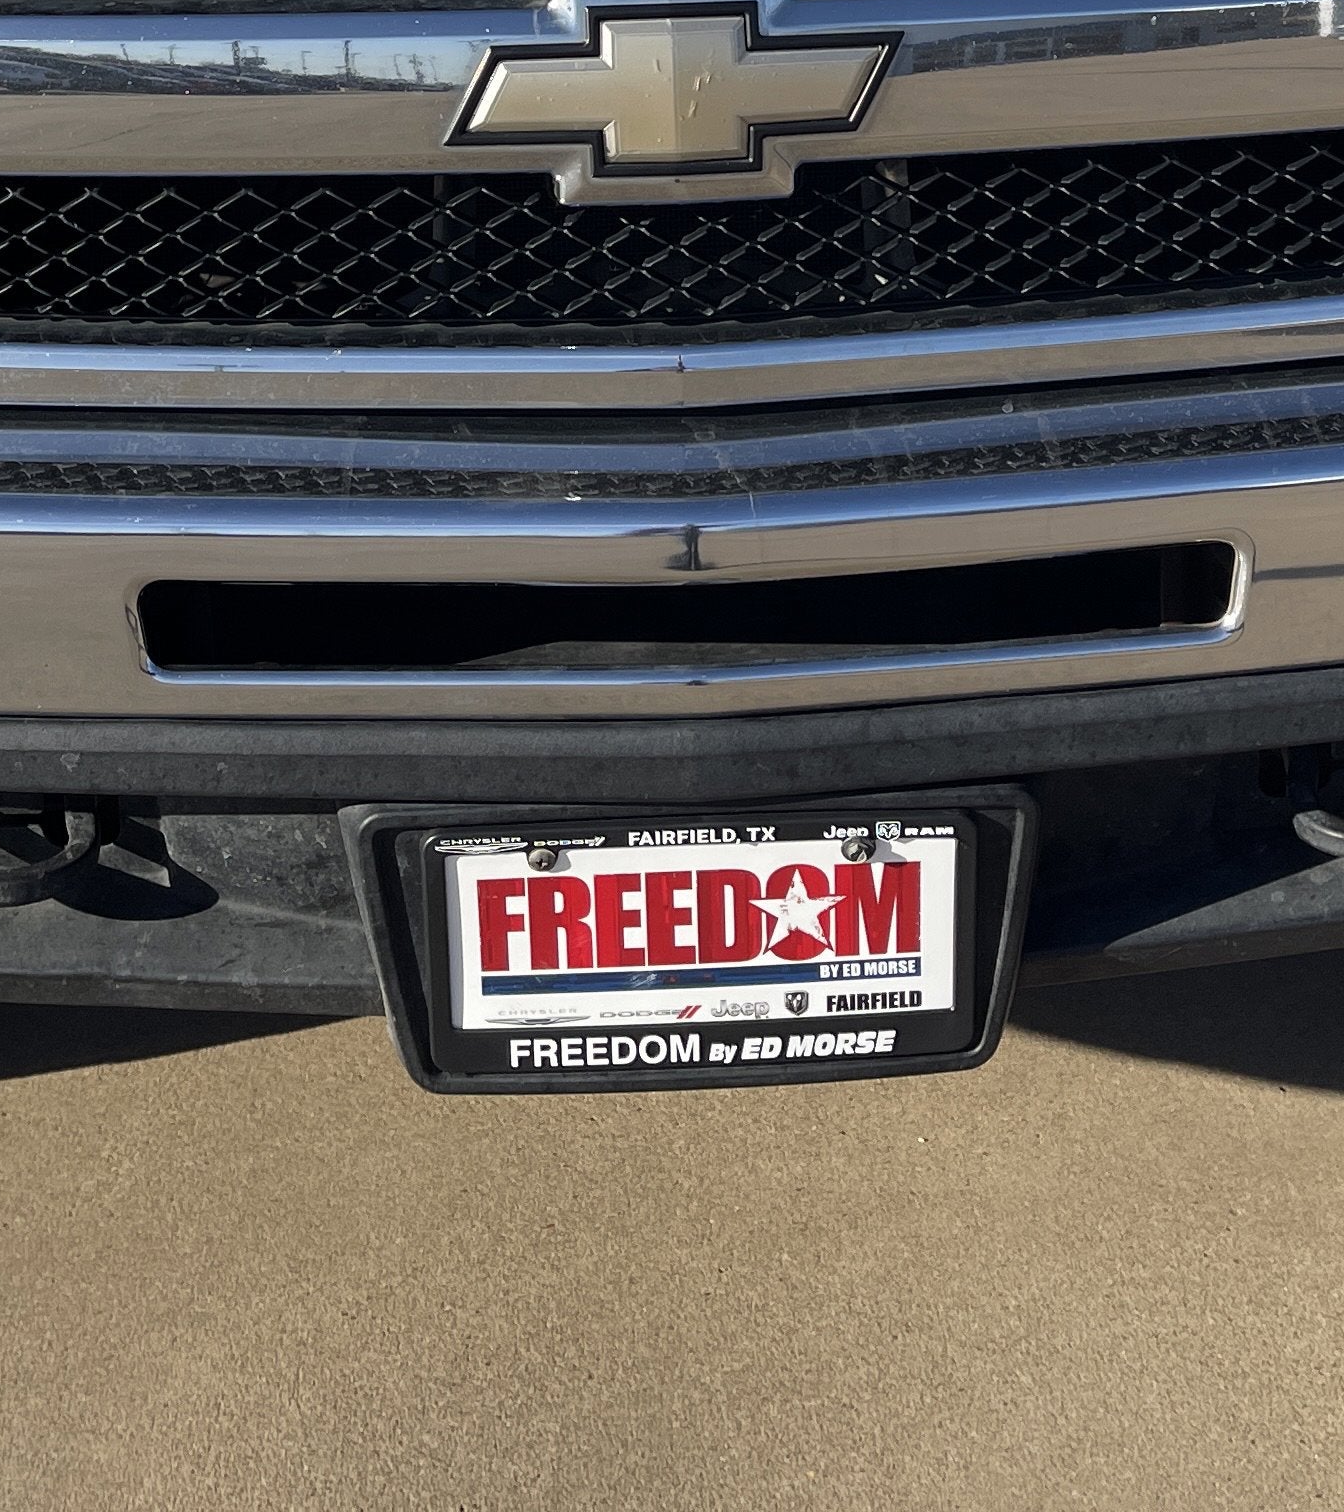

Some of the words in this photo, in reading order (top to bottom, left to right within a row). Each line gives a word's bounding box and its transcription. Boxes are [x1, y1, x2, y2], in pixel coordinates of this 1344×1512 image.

[439, 836, 522, 846] CHRYSLER
[628, 827, 741, 846] FAIRFIELD,
[746, 826, 776, 841] TX
[904, 826, 954, 836] RAM
[476, 861, 922, 972] FREEDOM
[819, 964, 839, 979] BY
[842, 962, 861, 977] ED
[864, 959, 917, 976] MORSE
[711, 999, 770, 1019] Jeep
[826, 990, 923, 1013] FAIRFIELD
[498, 1008, 578, 1017] CHRYSLER
[509, 1033, 702, 1069] FREEDOM
[709, 1042, 738, 1064] By
[740, 1036, 783, 1060] ED
[785, 1029, 897, 1058] MORSE
